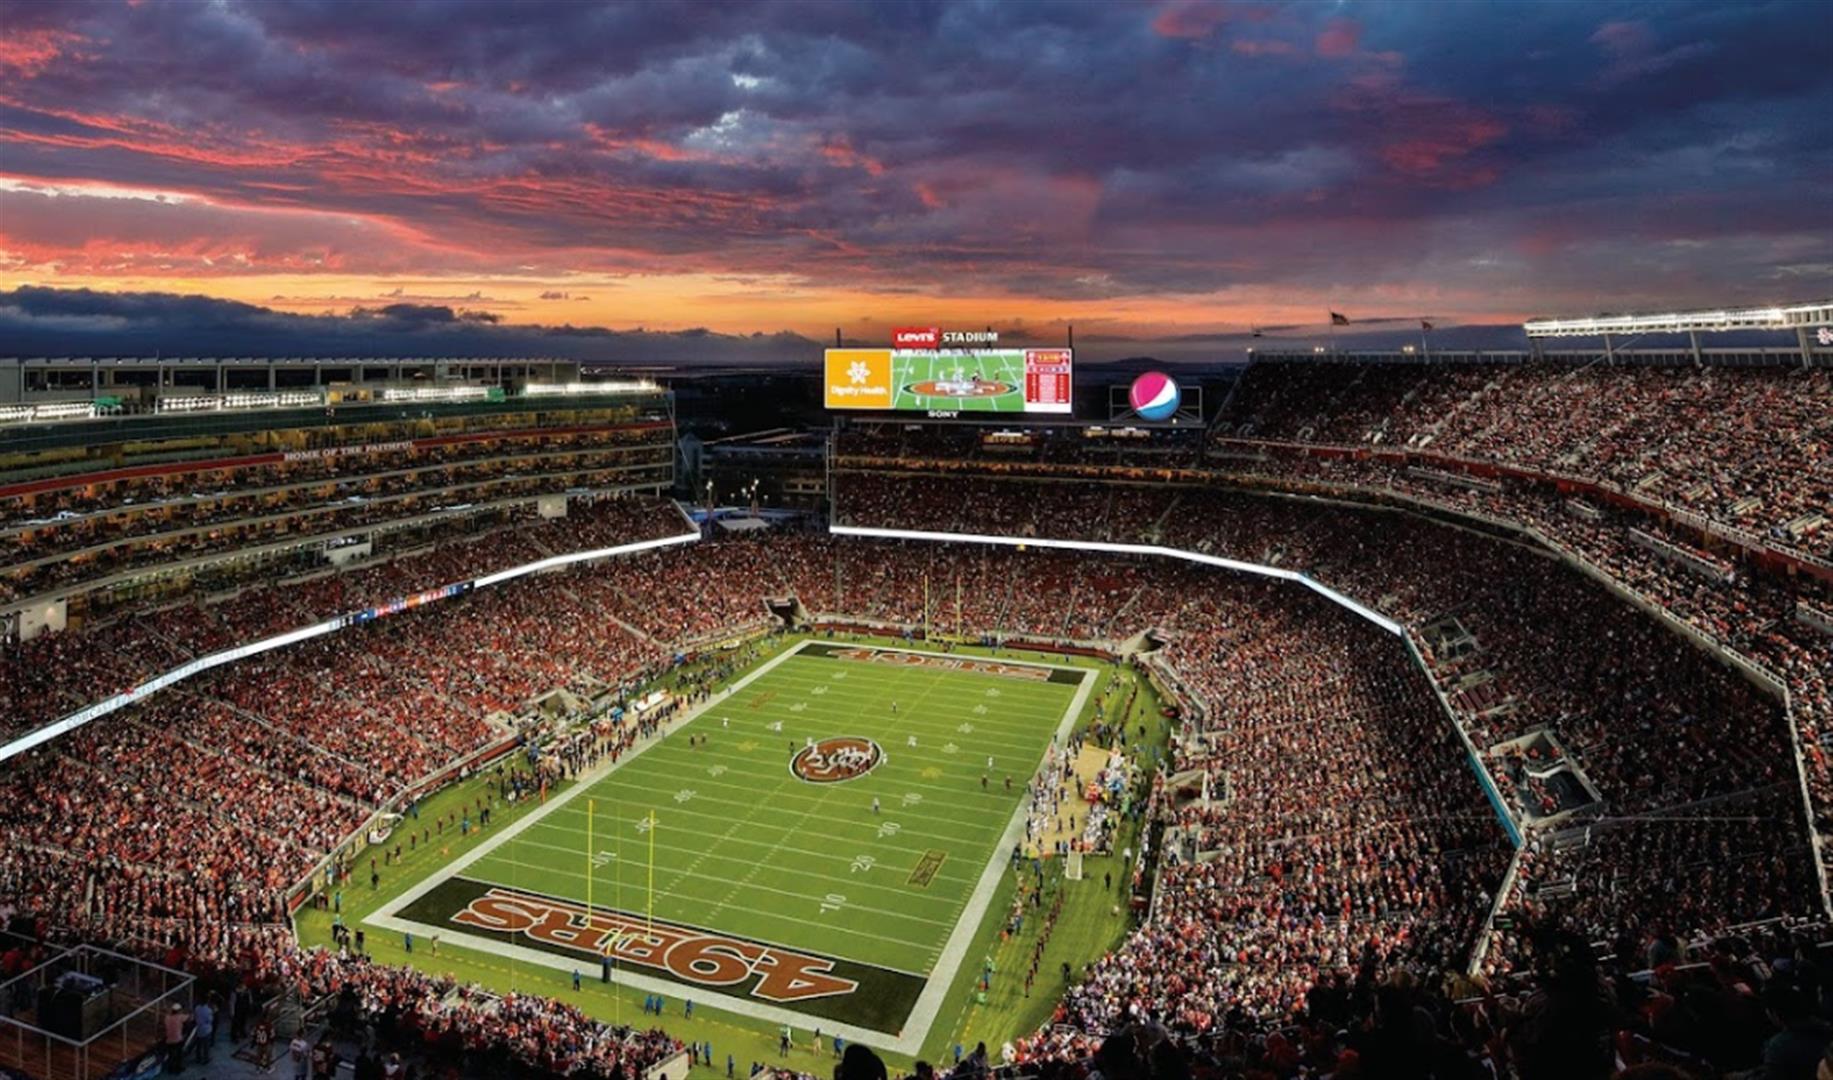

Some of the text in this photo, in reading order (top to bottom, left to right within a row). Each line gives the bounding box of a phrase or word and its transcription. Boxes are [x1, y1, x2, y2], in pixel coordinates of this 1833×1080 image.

[943, 332, 998, 342] STADIUM
[927, 410, 958, 418] SONY
[284, 451, 319, 461] HOME
[322, 448, 338, 457] OF
[450, 888, 859, 1002] 49ERS
